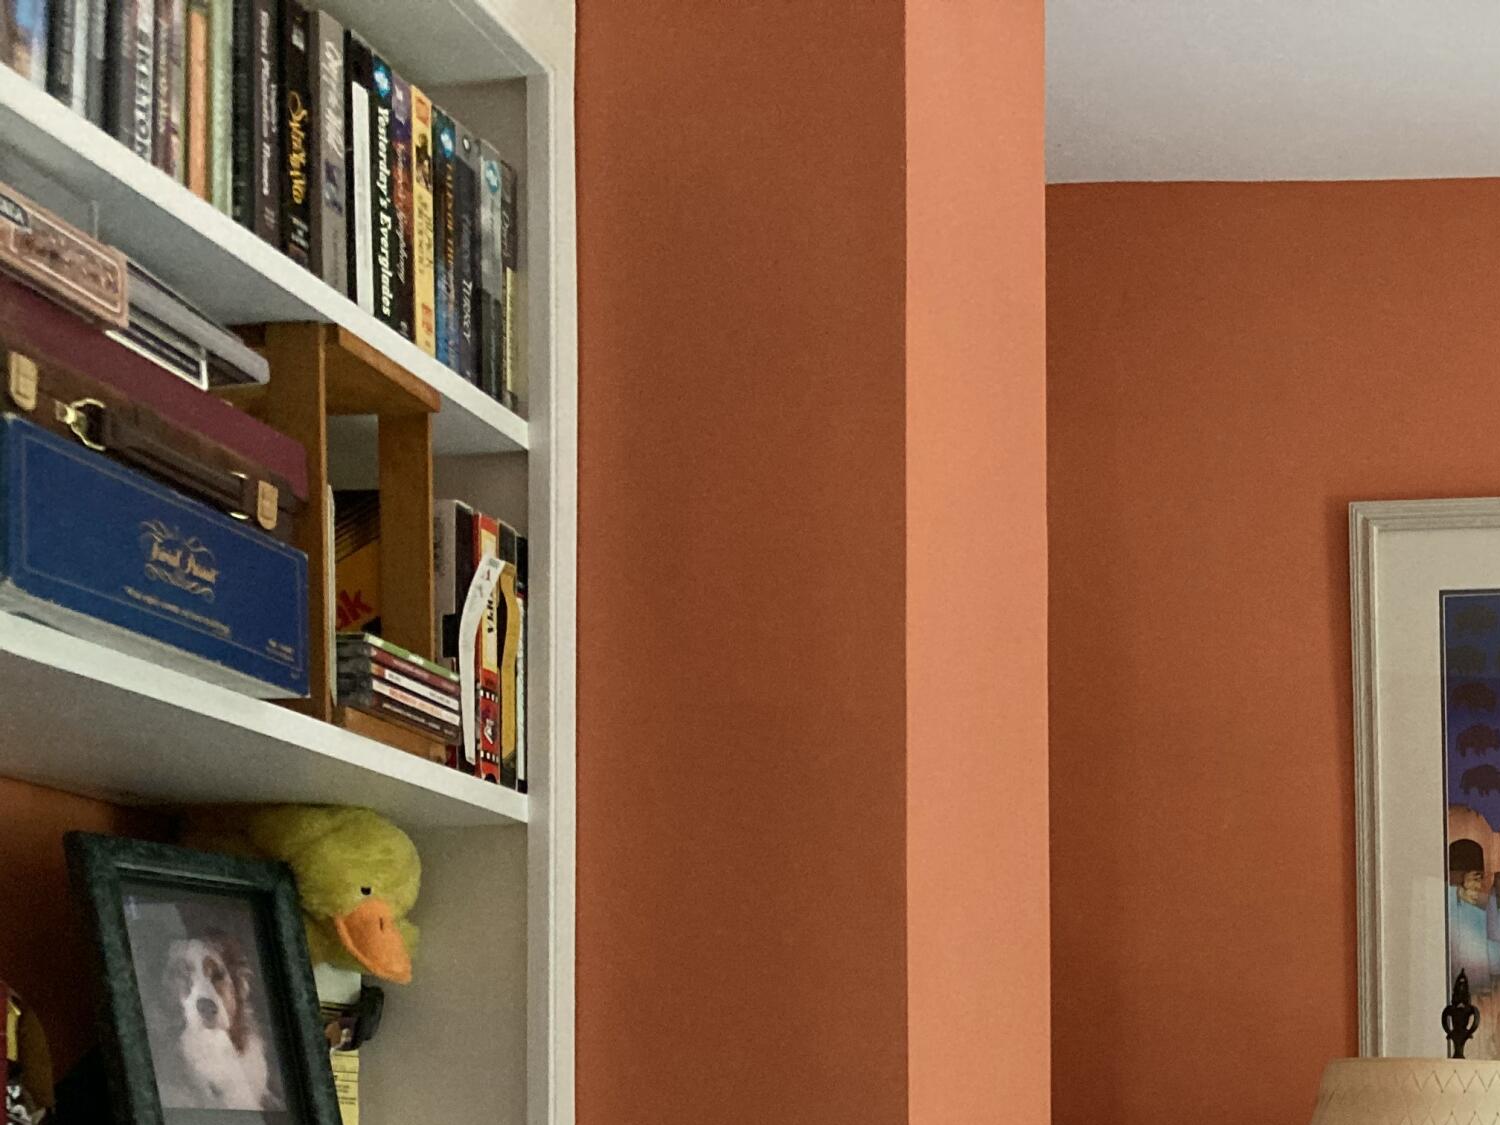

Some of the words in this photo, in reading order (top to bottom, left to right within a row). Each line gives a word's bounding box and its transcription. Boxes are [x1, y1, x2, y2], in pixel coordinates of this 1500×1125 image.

[377, 105, 390, 208] Yesterday's
[378, 212, 392, 316] Everglades
[461, 279, 473, 343] TURKEY
